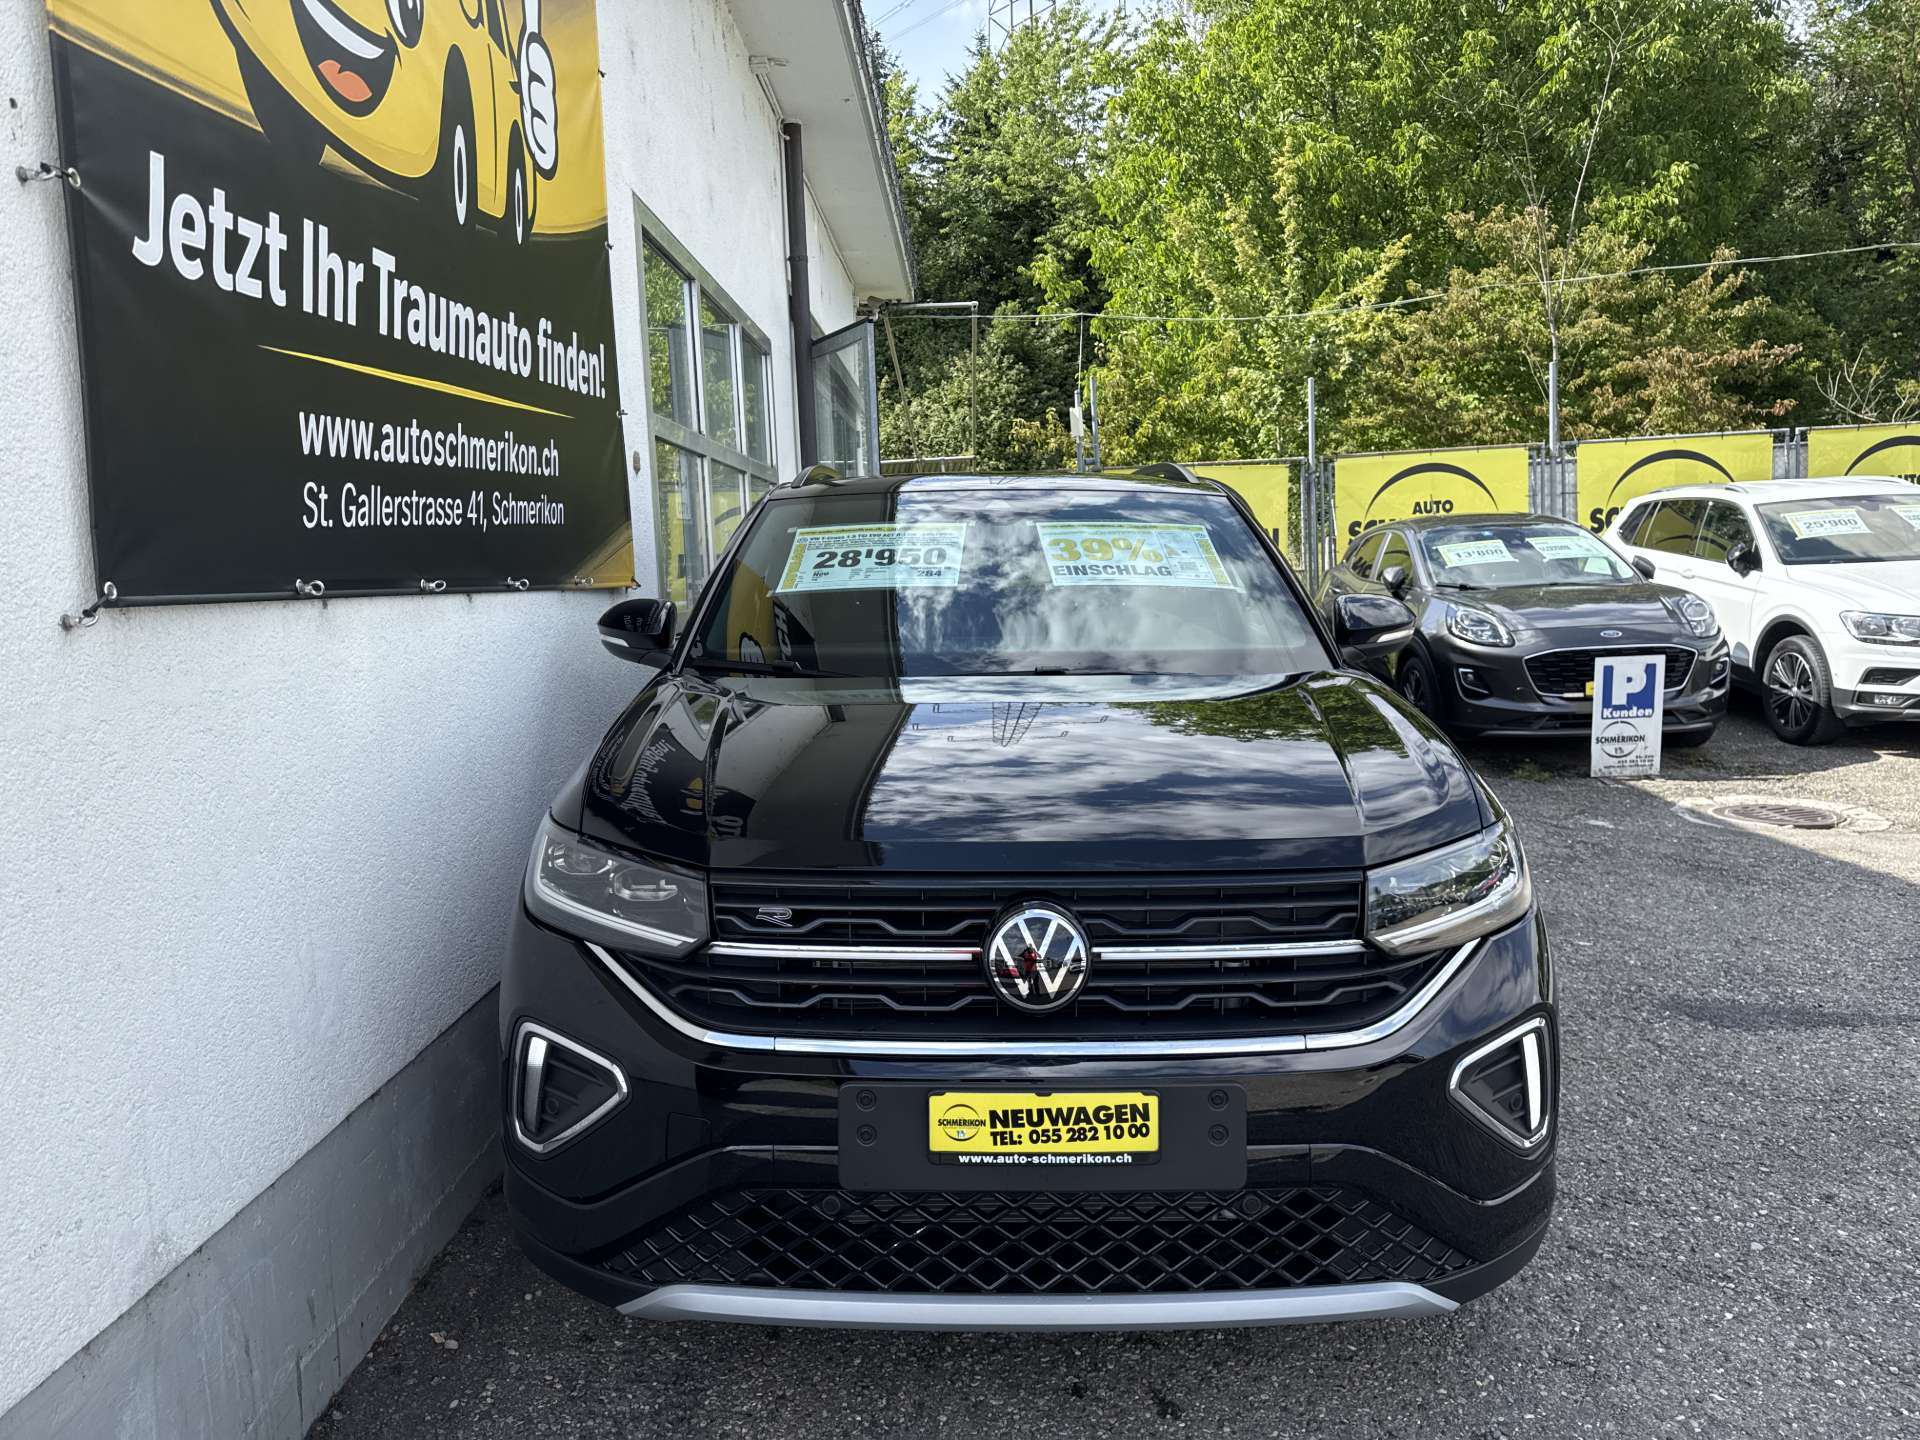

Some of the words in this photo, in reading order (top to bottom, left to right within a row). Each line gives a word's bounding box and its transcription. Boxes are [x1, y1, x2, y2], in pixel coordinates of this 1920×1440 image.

[132, 150, 288, 307] Jetzt
[302, 217, 365, 327] Ihr
[372, 247, 532, 378] Traumauto
[537, 317, 606, 399] finden!
[299, 411, 560, 477] www.autoschmerikon.ch
[302, 481, 333, 529] St.
[341, 482, 463, 528] Gallerstrasse
[466, 490, 487, 533] 41,
[492, 491, 565, 526] Schmerikon
[1412, 499, 1454, 515] AUTO
[813, 547, 948, 570] 28'950
[1048, 536, 1165, 563] 39%
[1053, 564, 1173, 577] EINSCHLAG
[1611, 663, 1647, 706] P
[1603, 706, 1654, 719] Kunden
[1595, 734, 1646, 745] SCHMERIKON
[937, 1118, 986, 1127] SCHMERIKON
[988, 1103, 1151, 1129] NEUWAGEN
[990, 1130, 1023, 1146] TEL:
[1028, 1128, 1062, 1145] 055
[1066, 1126, 1100, 1143] 282
[1103, 1125, 1125, 1140] 10
[1127, 1123, 1151, 1139] 00
[958, 1153, 1133, 1164] www.auto-schmerikon.ch
